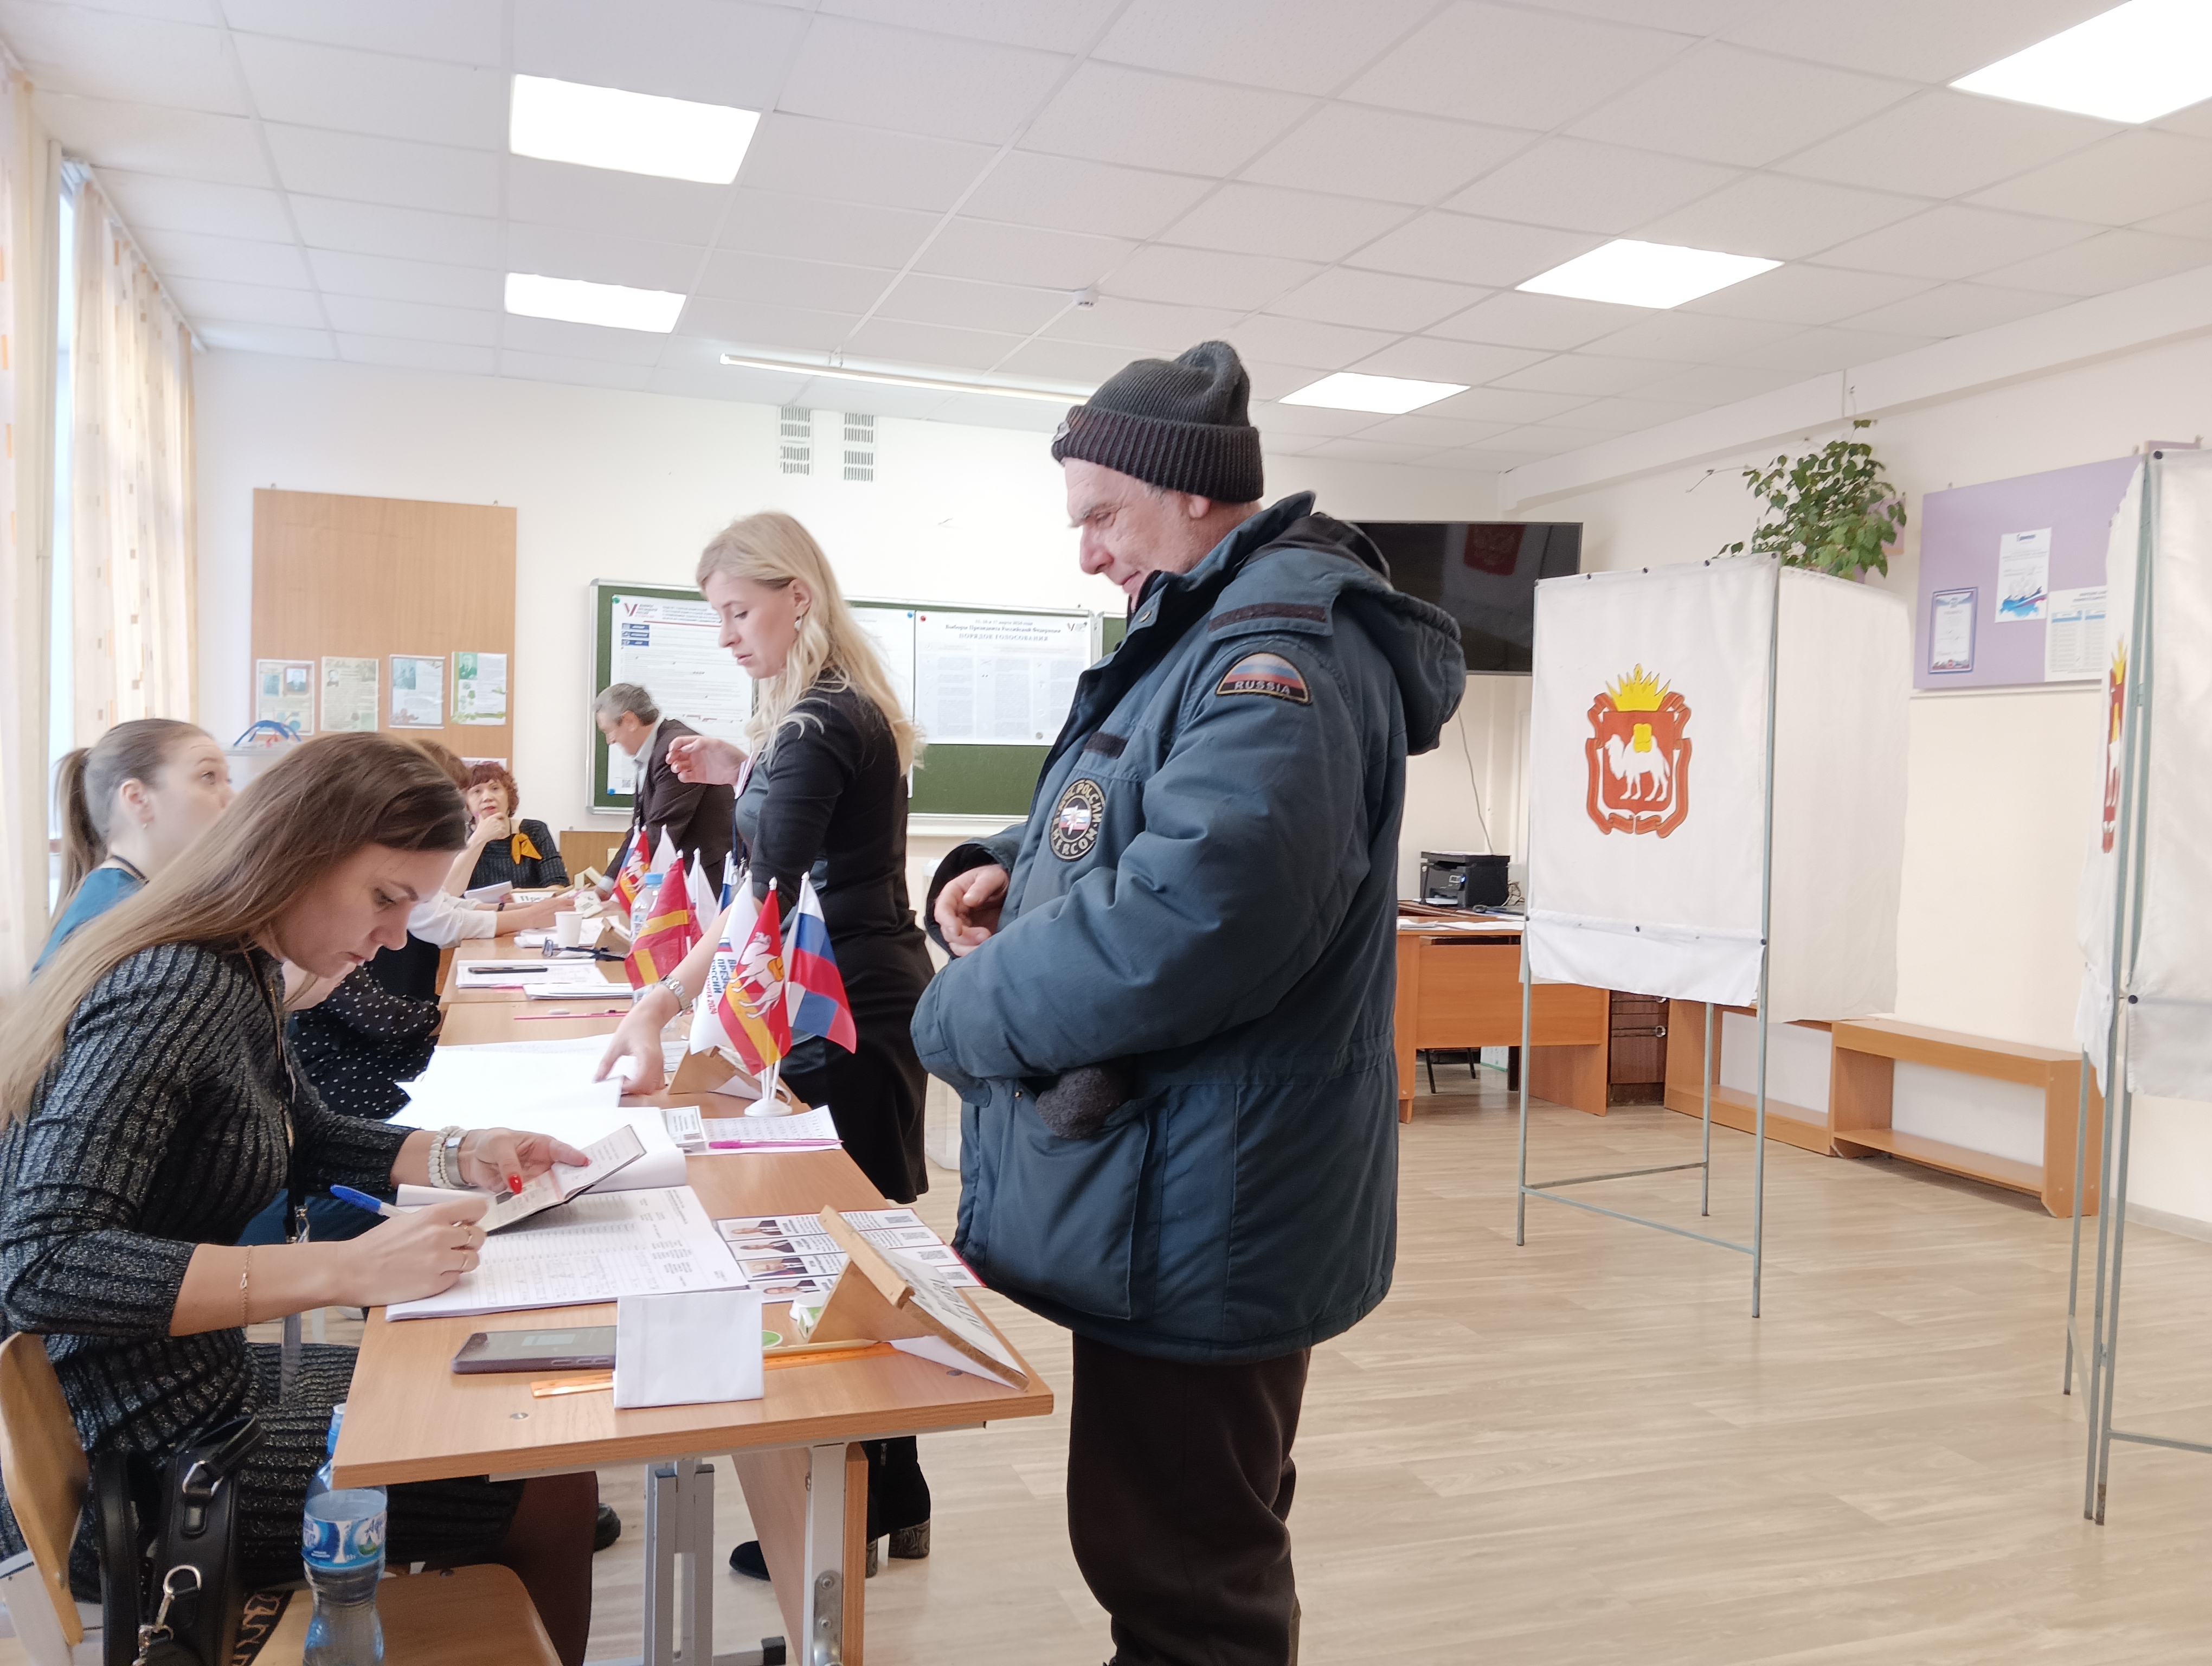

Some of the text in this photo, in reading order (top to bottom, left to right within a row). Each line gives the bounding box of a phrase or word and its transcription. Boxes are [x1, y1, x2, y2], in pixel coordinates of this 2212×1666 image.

[1234, 680, 1291, 695] RUSSIA
[1076, 783, 1103, 823] РОССИИ
[707, 999, 718, 1015] 2024
